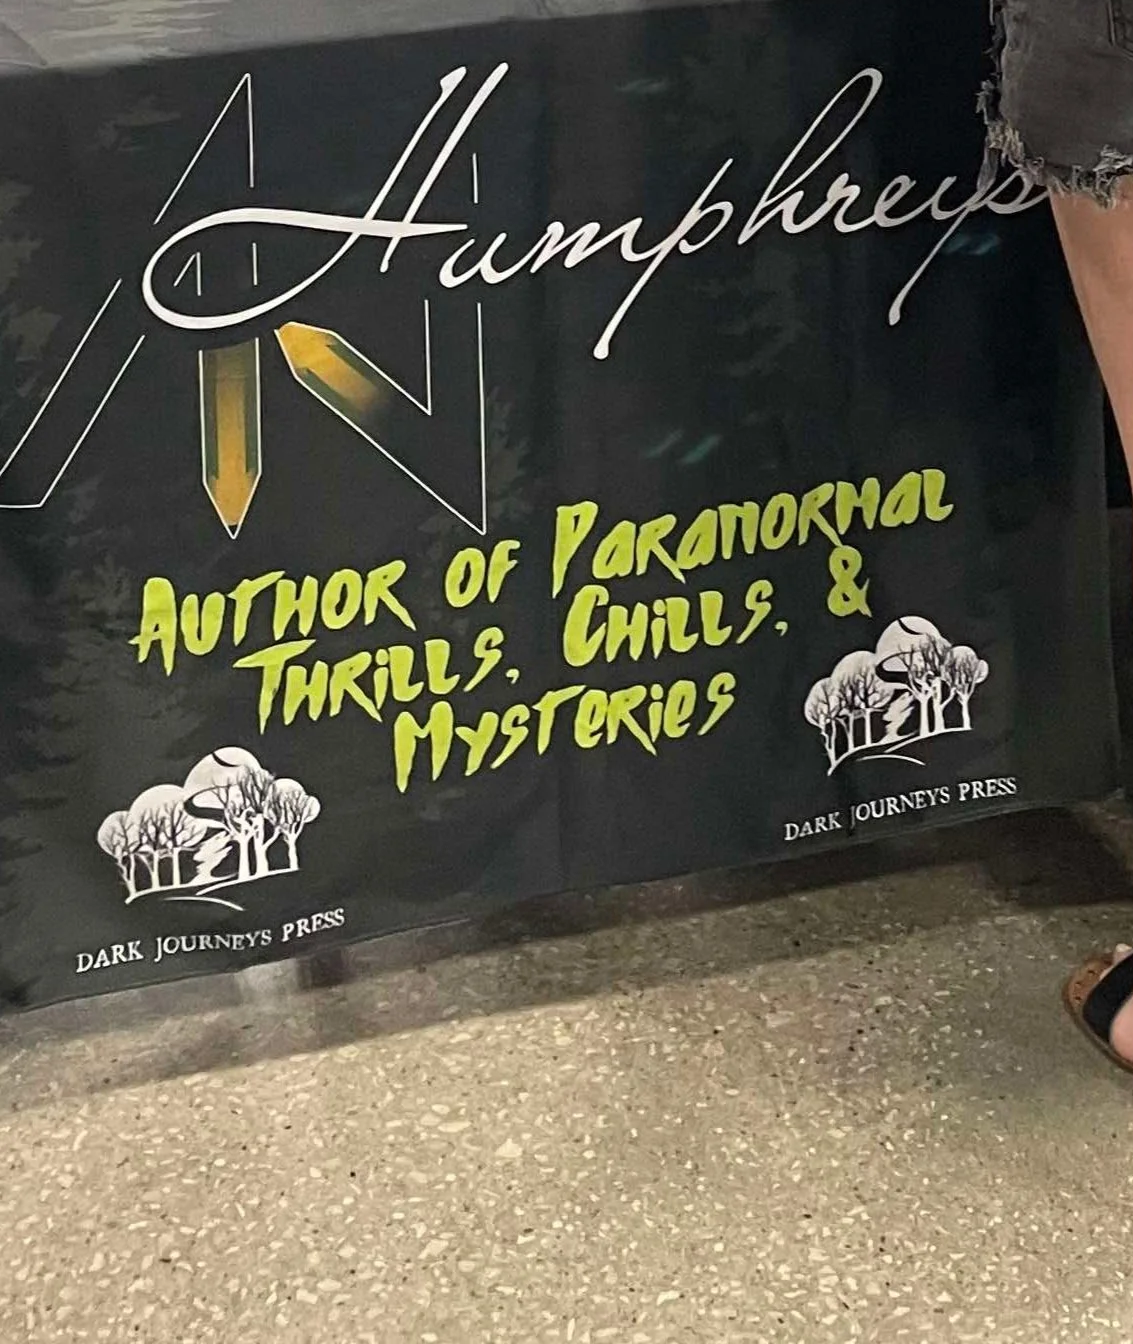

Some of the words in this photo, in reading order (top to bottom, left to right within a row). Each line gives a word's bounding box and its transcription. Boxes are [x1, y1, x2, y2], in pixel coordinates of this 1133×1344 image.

[142, 62, 1052, 360] Humphreys
[826, 544, 873, 618] &
[783, 811, 842, 842] DARK
[850, 786, 951, 830] JOURNEYS
[958, 776, 1018, 802] PRESS
[75, 939, 144, 974] DARK
[154, 929, 273, 963] JOURNEYS
[280, 907, 346, 943] PRESS
